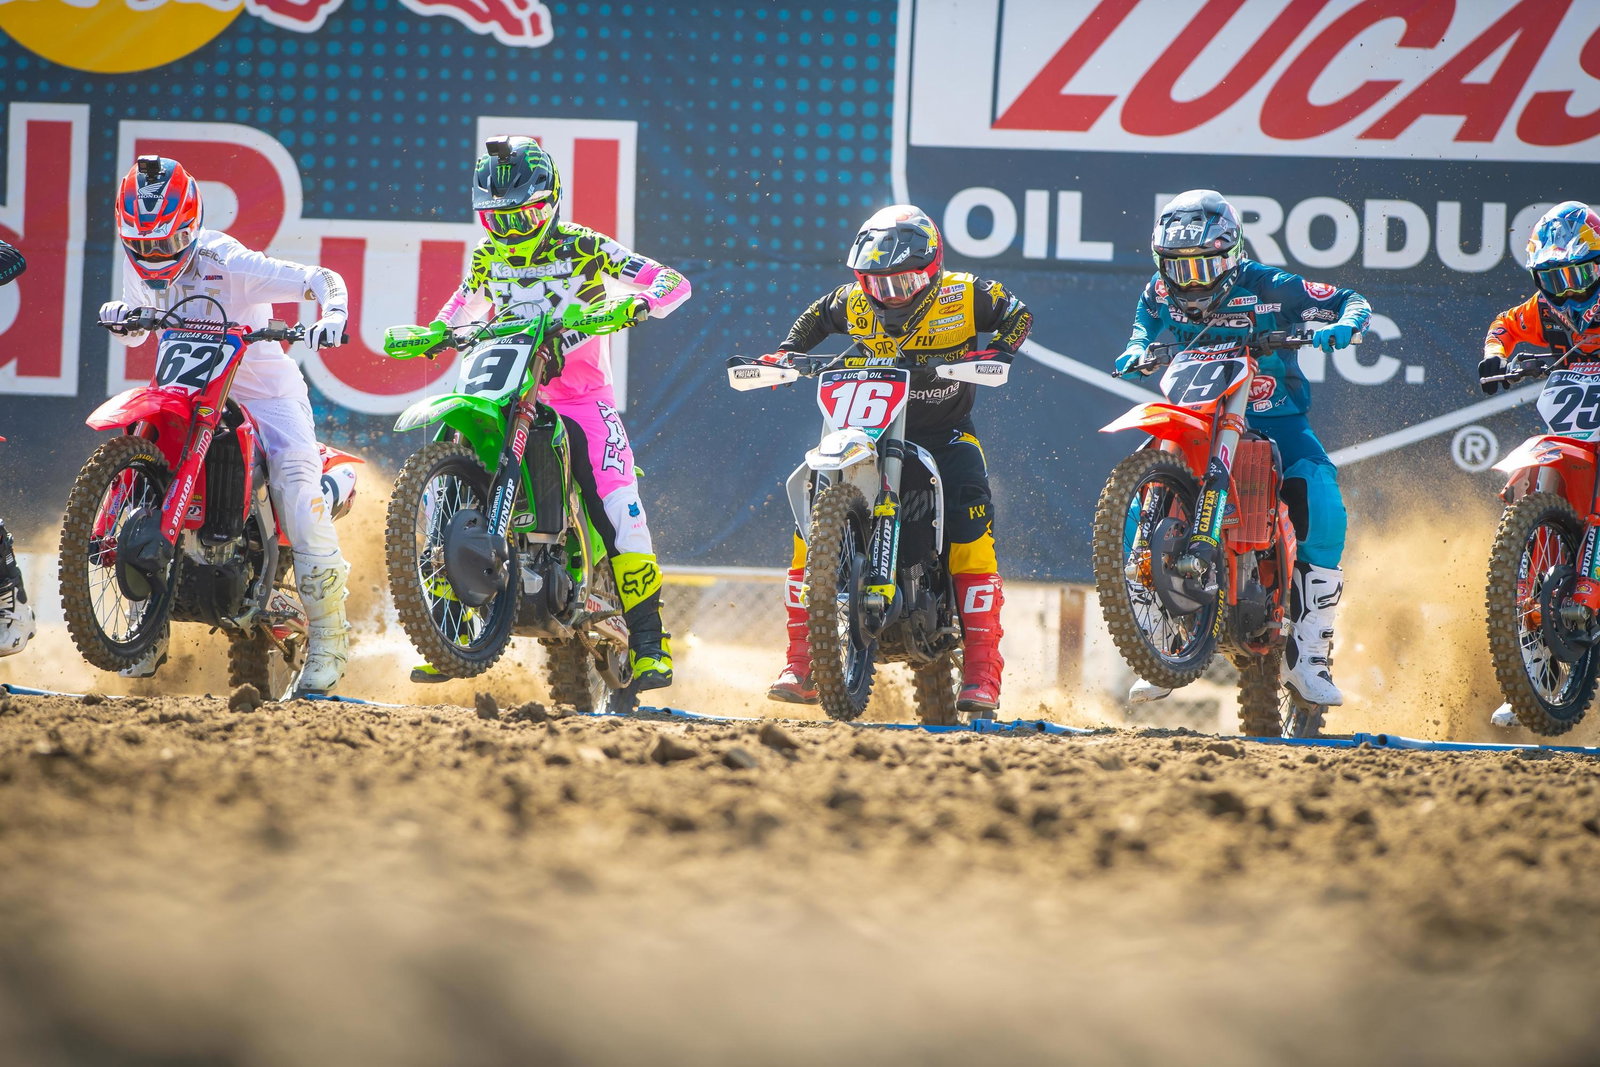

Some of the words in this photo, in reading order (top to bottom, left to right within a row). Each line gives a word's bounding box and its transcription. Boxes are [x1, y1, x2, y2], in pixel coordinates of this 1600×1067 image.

[944, 188, 1114, 261] OIL
[1155, 193, 1600, 277] RODU
[1169, 230, 1198, 241] FLY
[490, 257, 573, 278] Kawasaki
[1222, 269, 1239, 291] FLY
[940, 292, 964, 304] WPS
[1256, 304, 1281, 313] WPS
[572, 314, 615, 328] ACERBIS
[388, 337, 431, 349] ACERBIS
[915, 336, 935, 346] FLY
[916, 343, 970, 365] ROKSTR
[1188, 353, 1216, 361] LUCAS
[1215, 352, 1229, 360] OIL
[156, 342, 224, 388] 62
[464, 348, 519, 395] 9
[1167, 361, 1245, 405] 19
[831, 382, 893, 428] 16
[909, 380, 960, 400] sqvarna
[1549, 386, 1600, 432] 25
[171, 474, 193, 528] DUNLOP
[497, 478, 516, 538] DUNLOP
[1199, 489, 1216, 533] GALFER
[1215, 493, 1228, 529] MOTOREX
[881, 519, 892, 579] DUNLOP
[1212, 588, 1224, 639] DUNLOP
